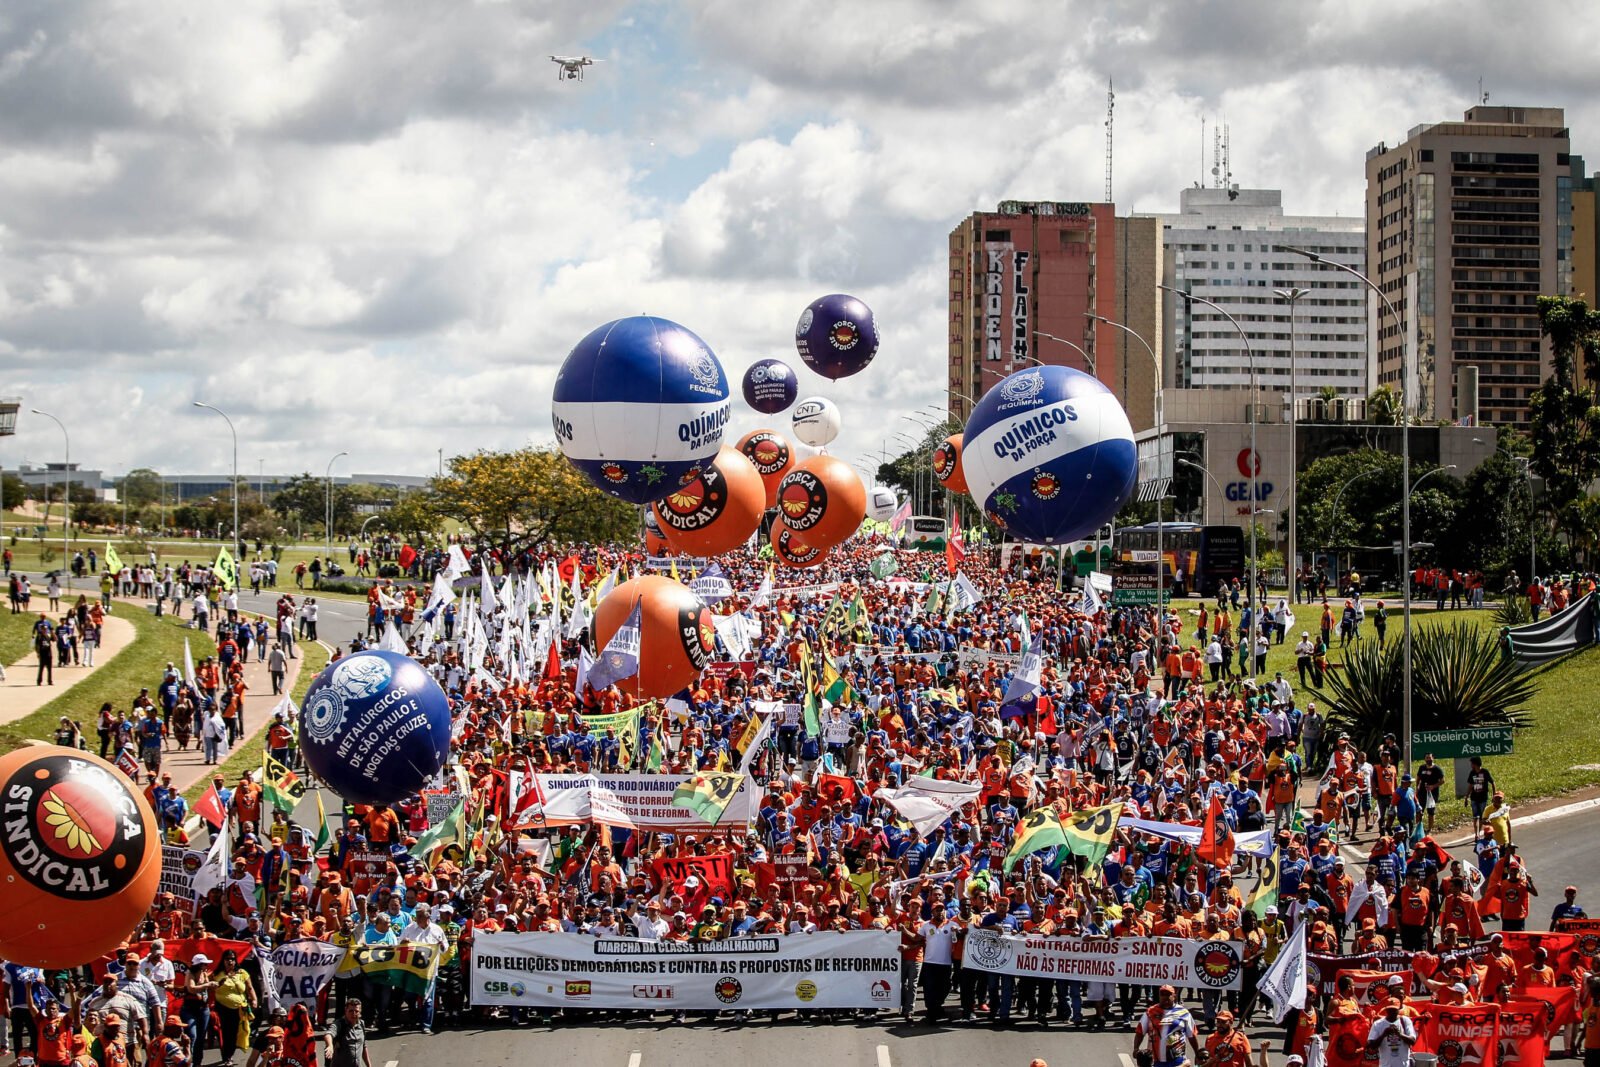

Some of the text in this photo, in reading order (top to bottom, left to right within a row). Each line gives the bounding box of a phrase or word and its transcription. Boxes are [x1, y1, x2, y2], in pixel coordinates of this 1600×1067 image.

[833, 320, 856, 331] FORÇA
[829, 336, 859, 350] SINDICAL
[689, 384, 722, 397] FEQUIMFAR
[797, 405, 816, 415] CNT
[997, 398, 1044, 412] FEQUIMFAR
[994, 404, 1078, 458] QUÍMICOS
[690, 427, 723, 450] DA FORÇA
[1011, 430, 1057, 462] DA FORÇA
[783, 472, 816, 492] FORÇA
[1033, 472, 1056, 483] FORÇA
[1032, 486, 1061, 500] SINDICAL
[1226, 482, 1274, 502] GEAP
[657, 498, 718, 529] INDICAL
[778, 504, 822, 530] SINDICAL
[786, 548, 820, 563] SINDIC
[683, 627, 711, 670] SINDIC
[336, 686, 408, 758] METALÚRGICOS
[350, 700, 418, 768] DE SÃO PAULO E
[1412, 730, 1500, 744] S. Hoteleiro Norte
[363, 713, 428, 779] MOGI DAS CRUZES
[1485, 743, 1501, 752] Sul
[548, 778, 595, 790] SINDICATO
[615, 794, 637, 804] TIVER
[639, 796, 672, 806] CORRUP
[640, 806, 651, 817] DE
[651, 808, 692, 818] REFORMA.
[4, 784, 109, 892] SINDICAL
[160, 872, 188, 886] BAIXO
[160, 883, 195, 900] TADURA
[598, 940, 776, 953] MARCHA DA CLASSE TRABALHADORA
[1025, 938, 1118, 955] SINTRACOMOS
[1132, 942, 1183, 957] SANTOS
[1200, 942, 1233, 958] FORÇA
[1450, 946, 1488, 957] Região
[353, 946, 432, 969] CGTB
[478, 955, 898, 973] POR ELEIÇÕES DEMOCRÁTICAS E CONTRA AS PROPOSTAS DE REFORMAS
[1017, 952, 1038, 970] NÃO
[1041, 953, 1054, 972] ÀS
[1057, 960, 1114, 976] REFORMAS
[1126, 963, 1168, 979] DIRETAS
[1172, 962, 1188, 980] JÁ!
[718, 977, 738, 986] FORÇA
[1196, 965, 1238, 986] SINDICAL
[484, 981, 509, 991] CSB
[567, 983, 590, 993] CTB
[633, 984, 670, 998] CUT
[715, 991, 742, 1003] SINDICAL
[1438, 1024, 1494, 1037] MINAS
[1499, 1024, 1532, 1036] NAS
